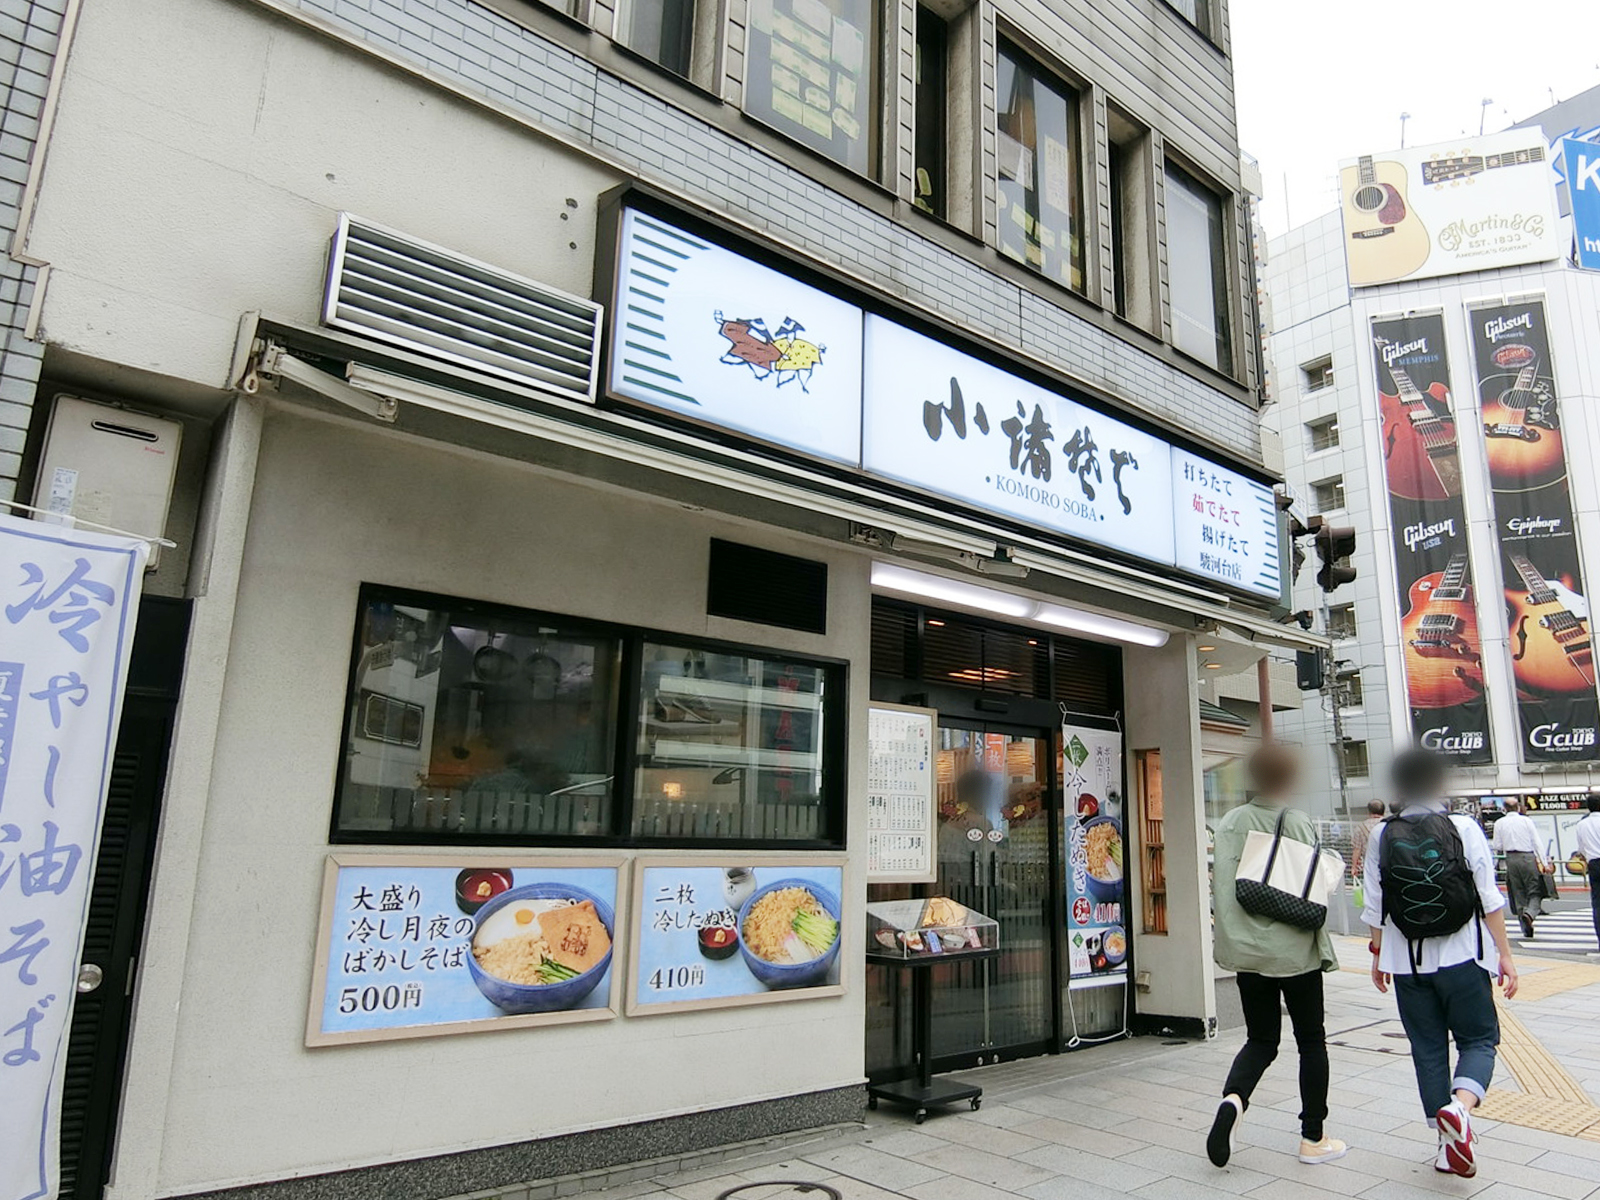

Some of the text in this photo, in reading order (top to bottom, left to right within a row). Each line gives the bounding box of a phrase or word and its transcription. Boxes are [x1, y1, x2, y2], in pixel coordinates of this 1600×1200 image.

[1483, 312, 1533, 343] Gibson
[1382, 337, 1428, 367] Gibson
[1398, 354, 1439, 366] MEMPHIS
[1184, 461, 1232, 496] 打ちたて
[996, 474, 1098, 522] KOMORO SOBA
[1192, 493, 1240, 527] 茹でたて
[1202, 523, 1248, 557] 揚げたて
[1403, 518, 1456, 552] Gibson
[1506, 515, 1561, 536] Epiphone
[1200, 551, 1242, 581] 駿河台店
[0, 557, 116, 1067] 冷やし油そば
[1539, 794, 1559, 802] JAZZ
[351, 884, 421, 912] 大盛り
[655, 884, 695, 905] 二枚
[347, 914, 474, 944] 冷し月夜の
[653, 908, 735, 932] 冷したぬき
[343, 943, 470, 974] ばかしそば
[649, 966, 704, 989] 410円
[339, 985, 422, 1014] 500円
